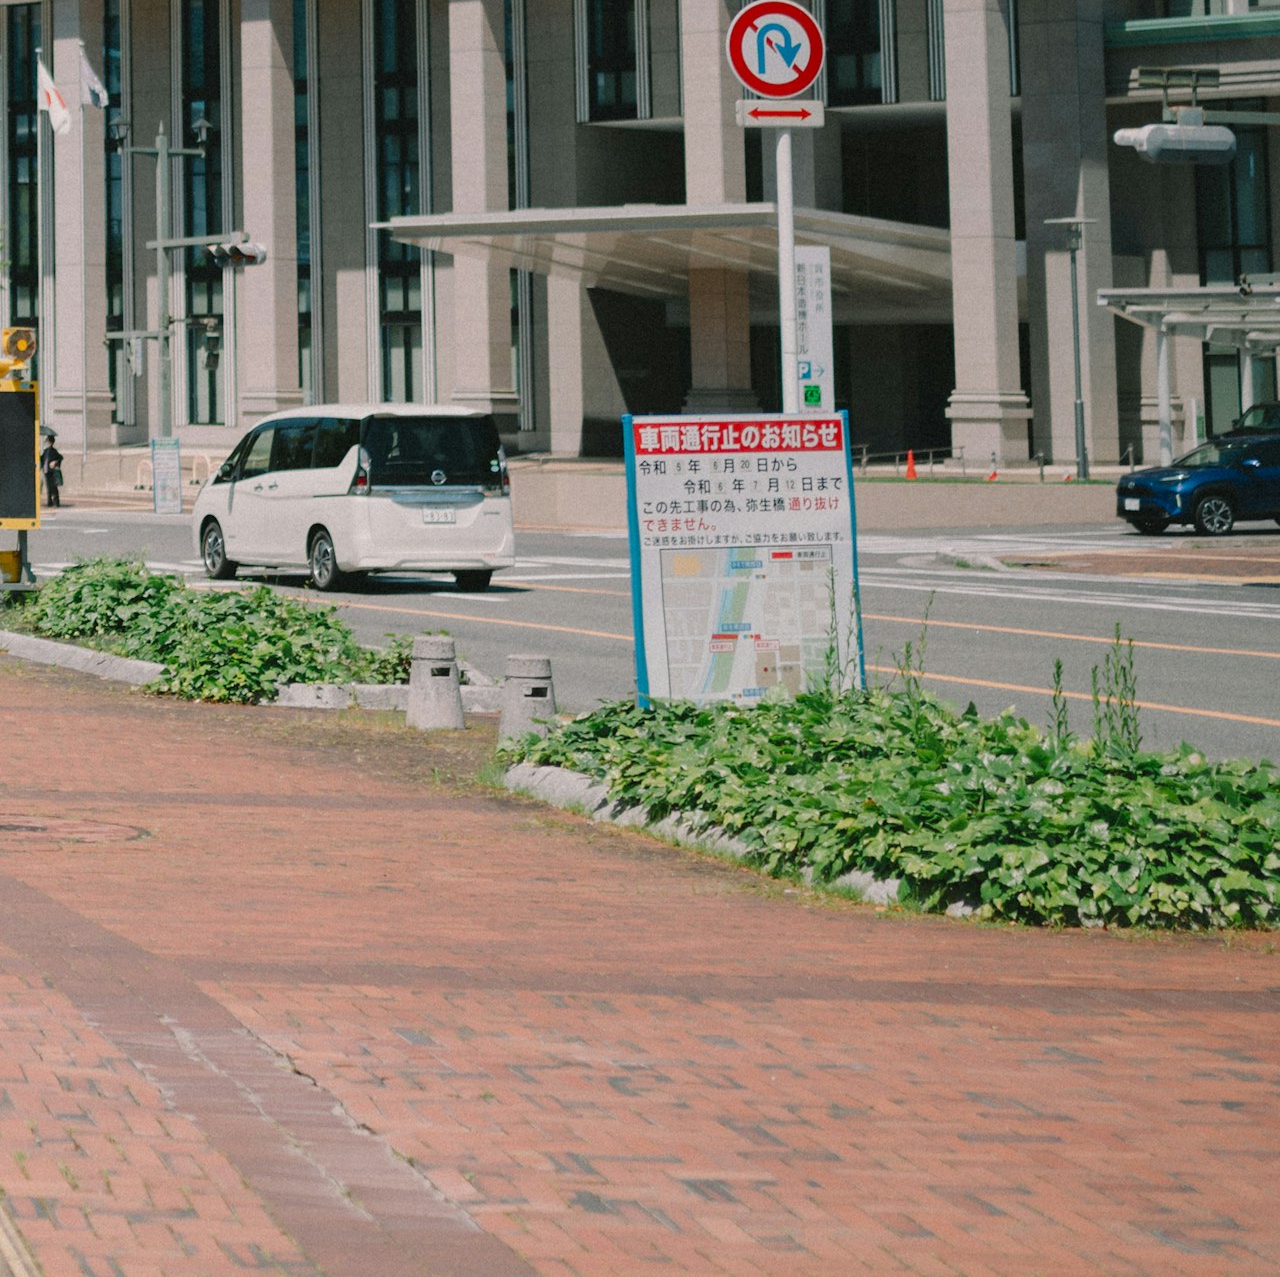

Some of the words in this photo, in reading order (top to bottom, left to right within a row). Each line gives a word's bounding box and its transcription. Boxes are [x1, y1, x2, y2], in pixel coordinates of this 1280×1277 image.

[639, 423, 839, 453] 車両通行止のお知らせ
[643, 518, 717, 532] できません。
